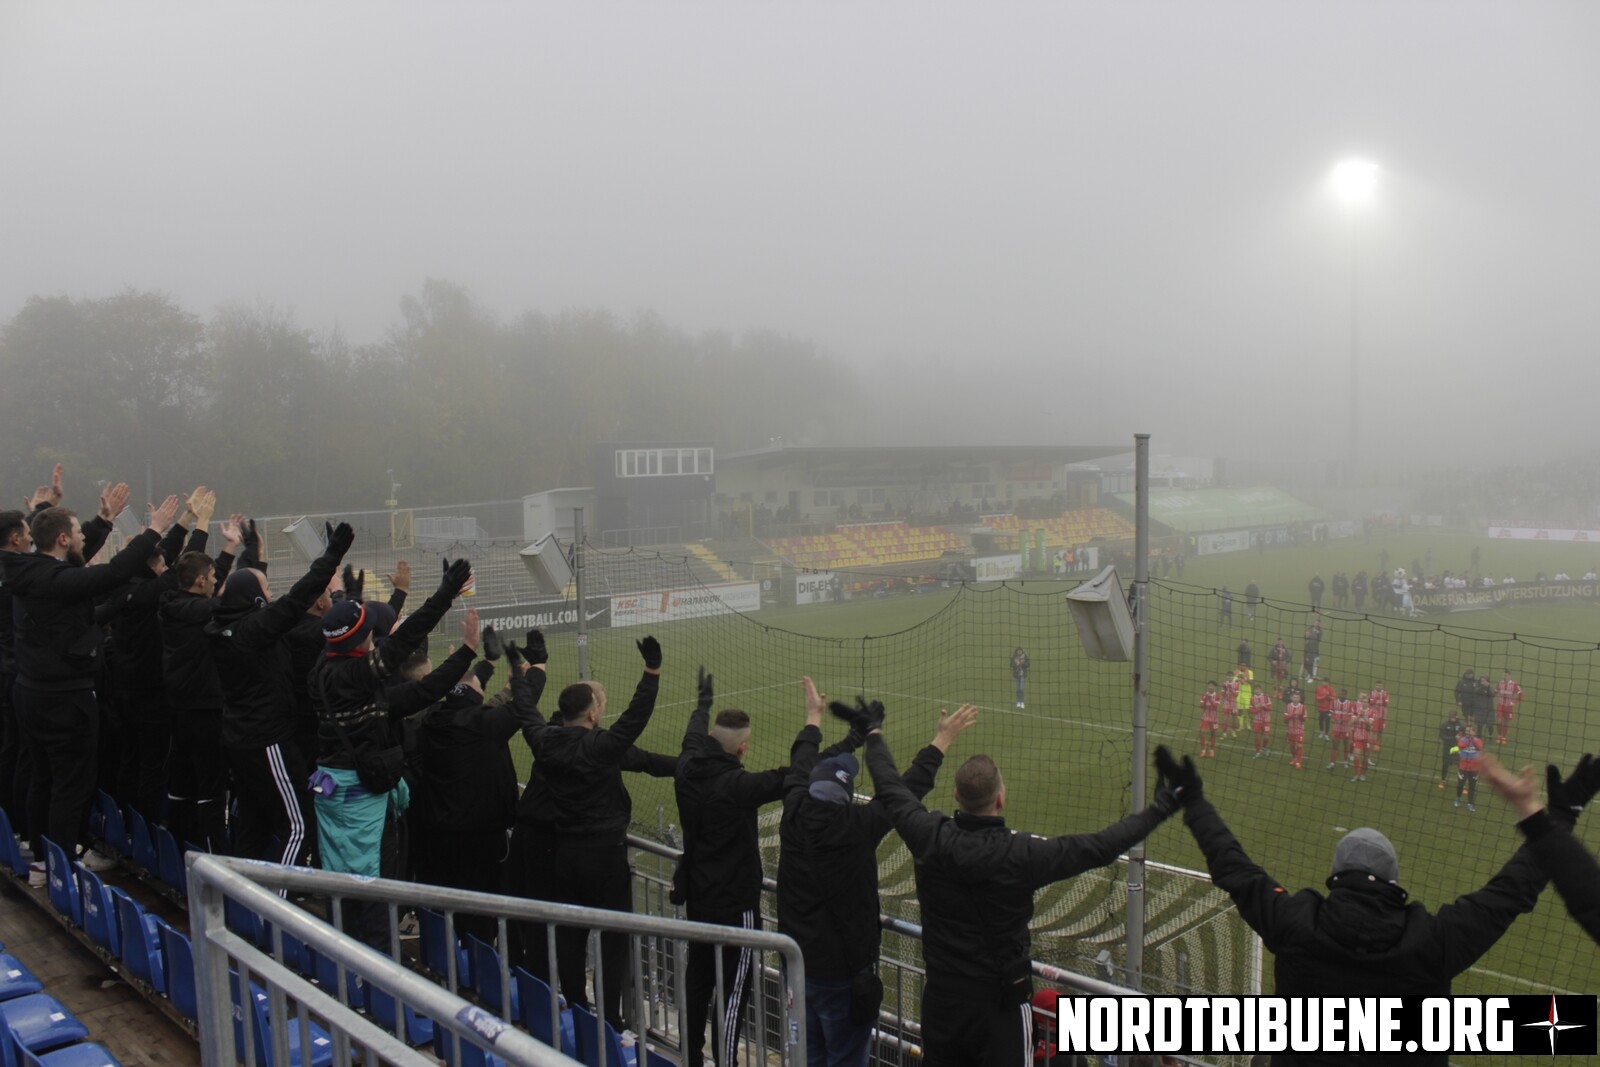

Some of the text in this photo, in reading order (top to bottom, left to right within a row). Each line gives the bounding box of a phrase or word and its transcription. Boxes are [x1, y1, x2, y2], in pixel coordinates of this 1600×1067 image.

[1414, 594, 1447, 606] DANKE
[1449, 591, 1464, 605] FÜR
[1465, 591, 1492, 604] EURE
[1494, 585, 1592, 601] UNTERSTÜTZUNG
[617, 599, 638, 609] KSC
